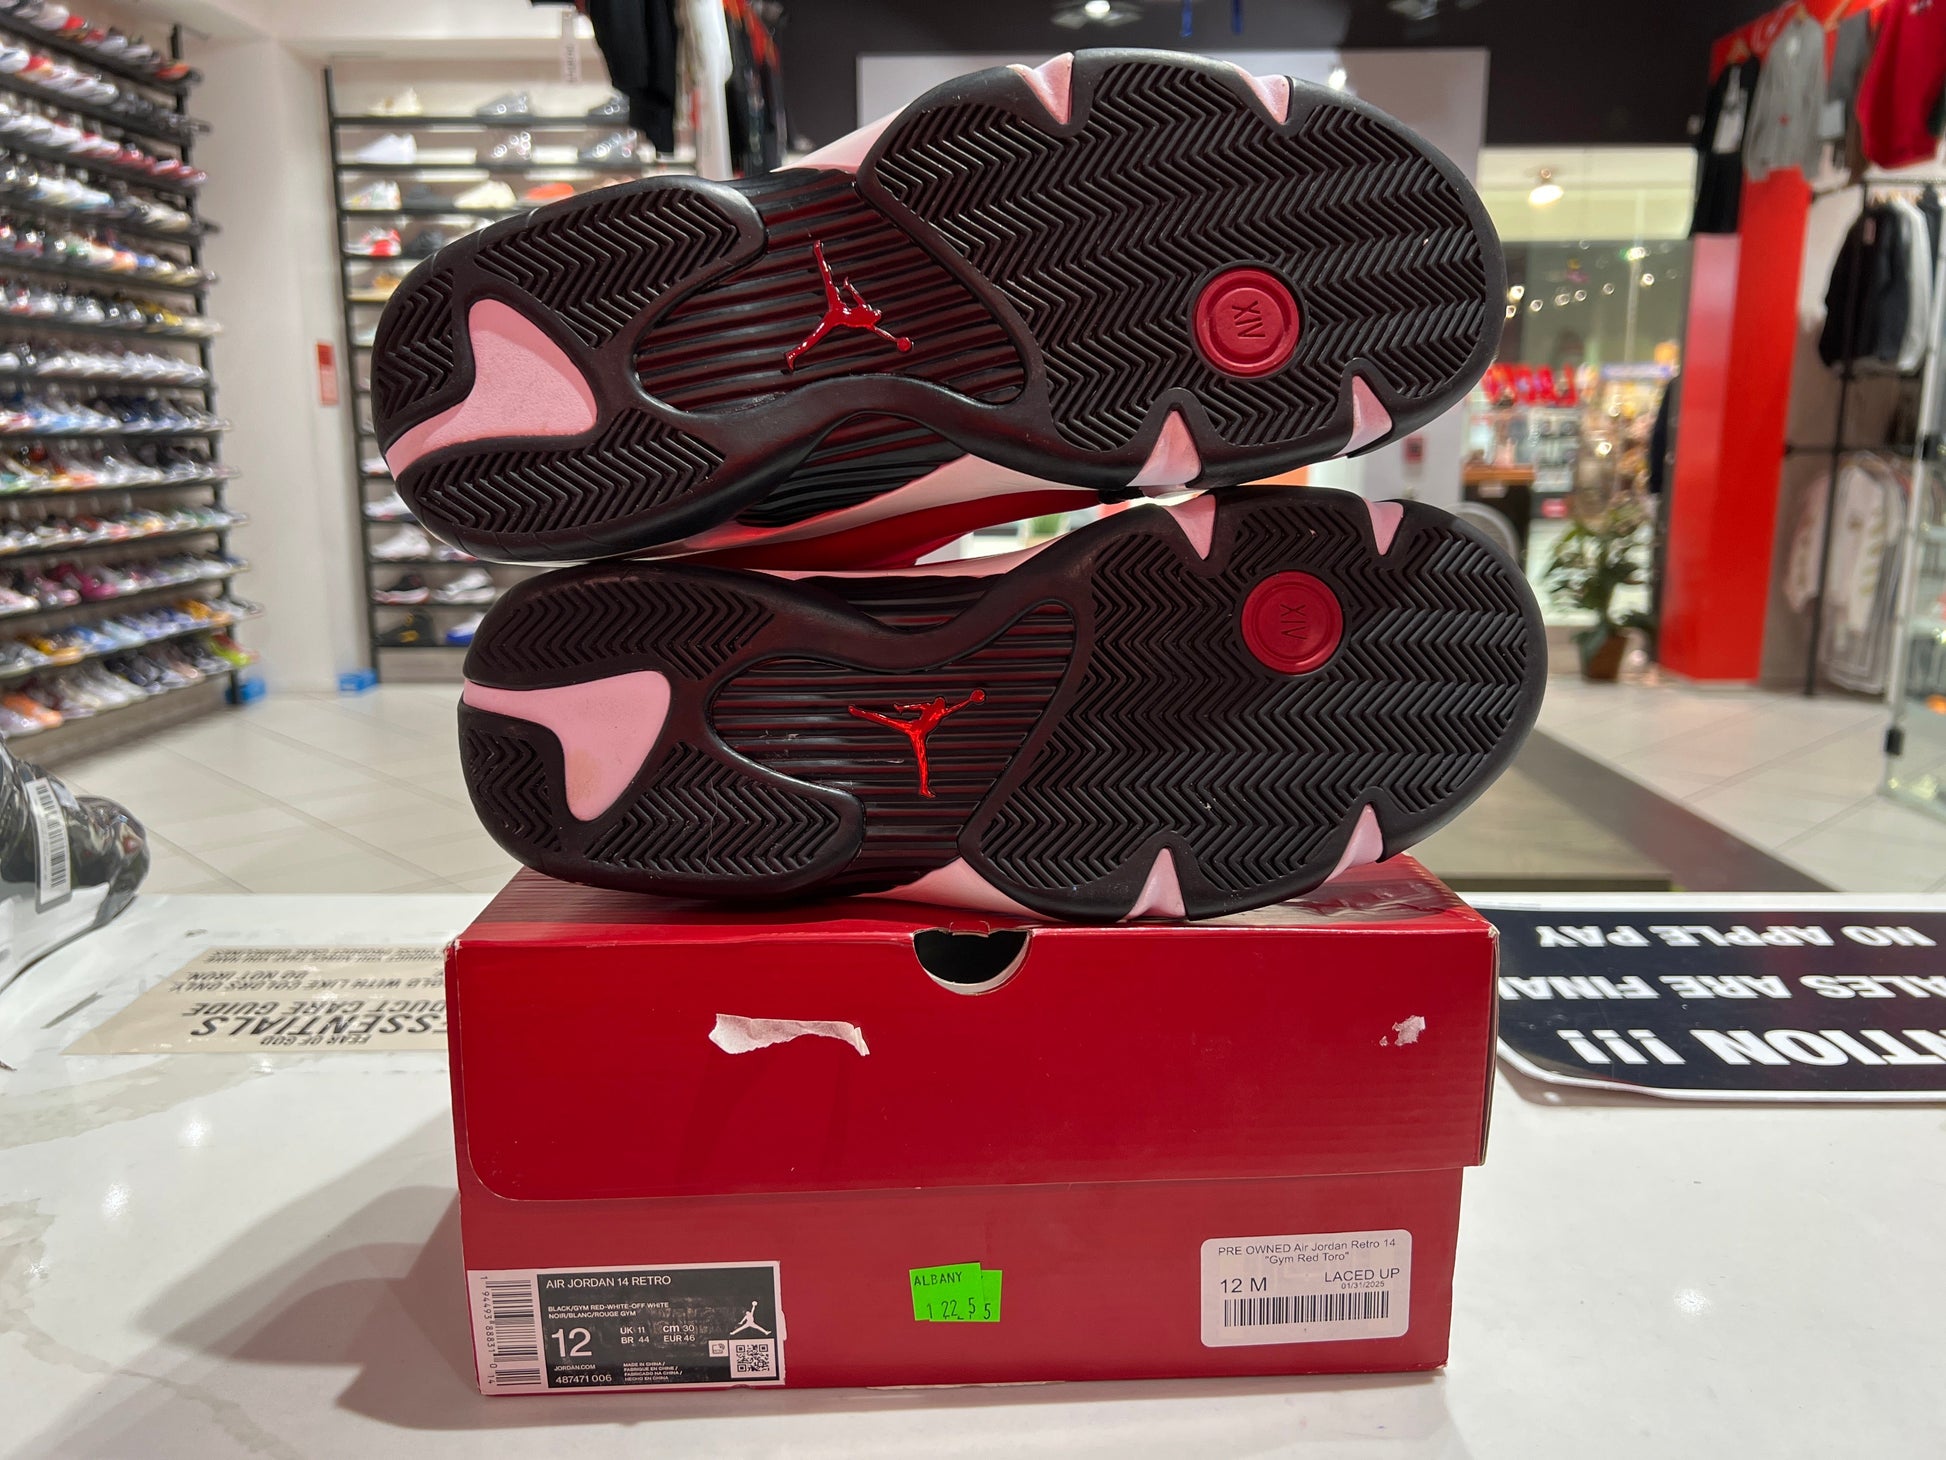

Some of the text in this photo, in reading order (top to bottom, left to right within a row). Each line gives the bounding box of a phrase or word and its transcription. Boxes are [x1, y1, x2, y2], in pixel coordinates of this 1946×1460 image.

[1231, 300, 1266, 340] XIV
[1280, 602, 1308, 641] XIV
[1535, 924, 1937, 948] NO APPLE PAY
[302, 979, 350, 990] LIKE
[351, 979, 401, 990] WITH
[1659, 975, 1793, 999] ARE
[182, 1001, 280, 1016] GUIDE
[282, 1001, 364, 1015] CARE
[260, 1034, 372, 1046] FEAR OF GOD
[1556, 1028, 1687, 1065] !!!
[1218, 1238, 1396, 1256] PRE OWNED Air Jordan Retro 14
[1265, 1251, 1349, 1266] "Gym Red Toro"
[546, 1275, 671, 1289] AIR JORDAN 14 RETRO
[914, 1272, 962, 1286] ALBANY
[1324, 1268, 1400, 1283] LACED UP
[1220, 1277, 1267, 1294] 12 M
[1341, 1280, 1385, 1289] 01/31/2025
[548, 1305, 589, 1313] BLACK/GYM
[548, 1310, 619, 1319] NOIR/BLANC/ROUGE
[620, 1326, 645, 1335] UK 11
[663, 1324, 695, 1333] cm 30
[551, 1327, 593, 1358] 12
[621, 1336, 634, 1344] BR
[663, 1334, 696, 1343] EUR 46
[554, 1364, 596, 1372] JORDAN.COM
[555, 1374, 612, 1384] 487471 006
